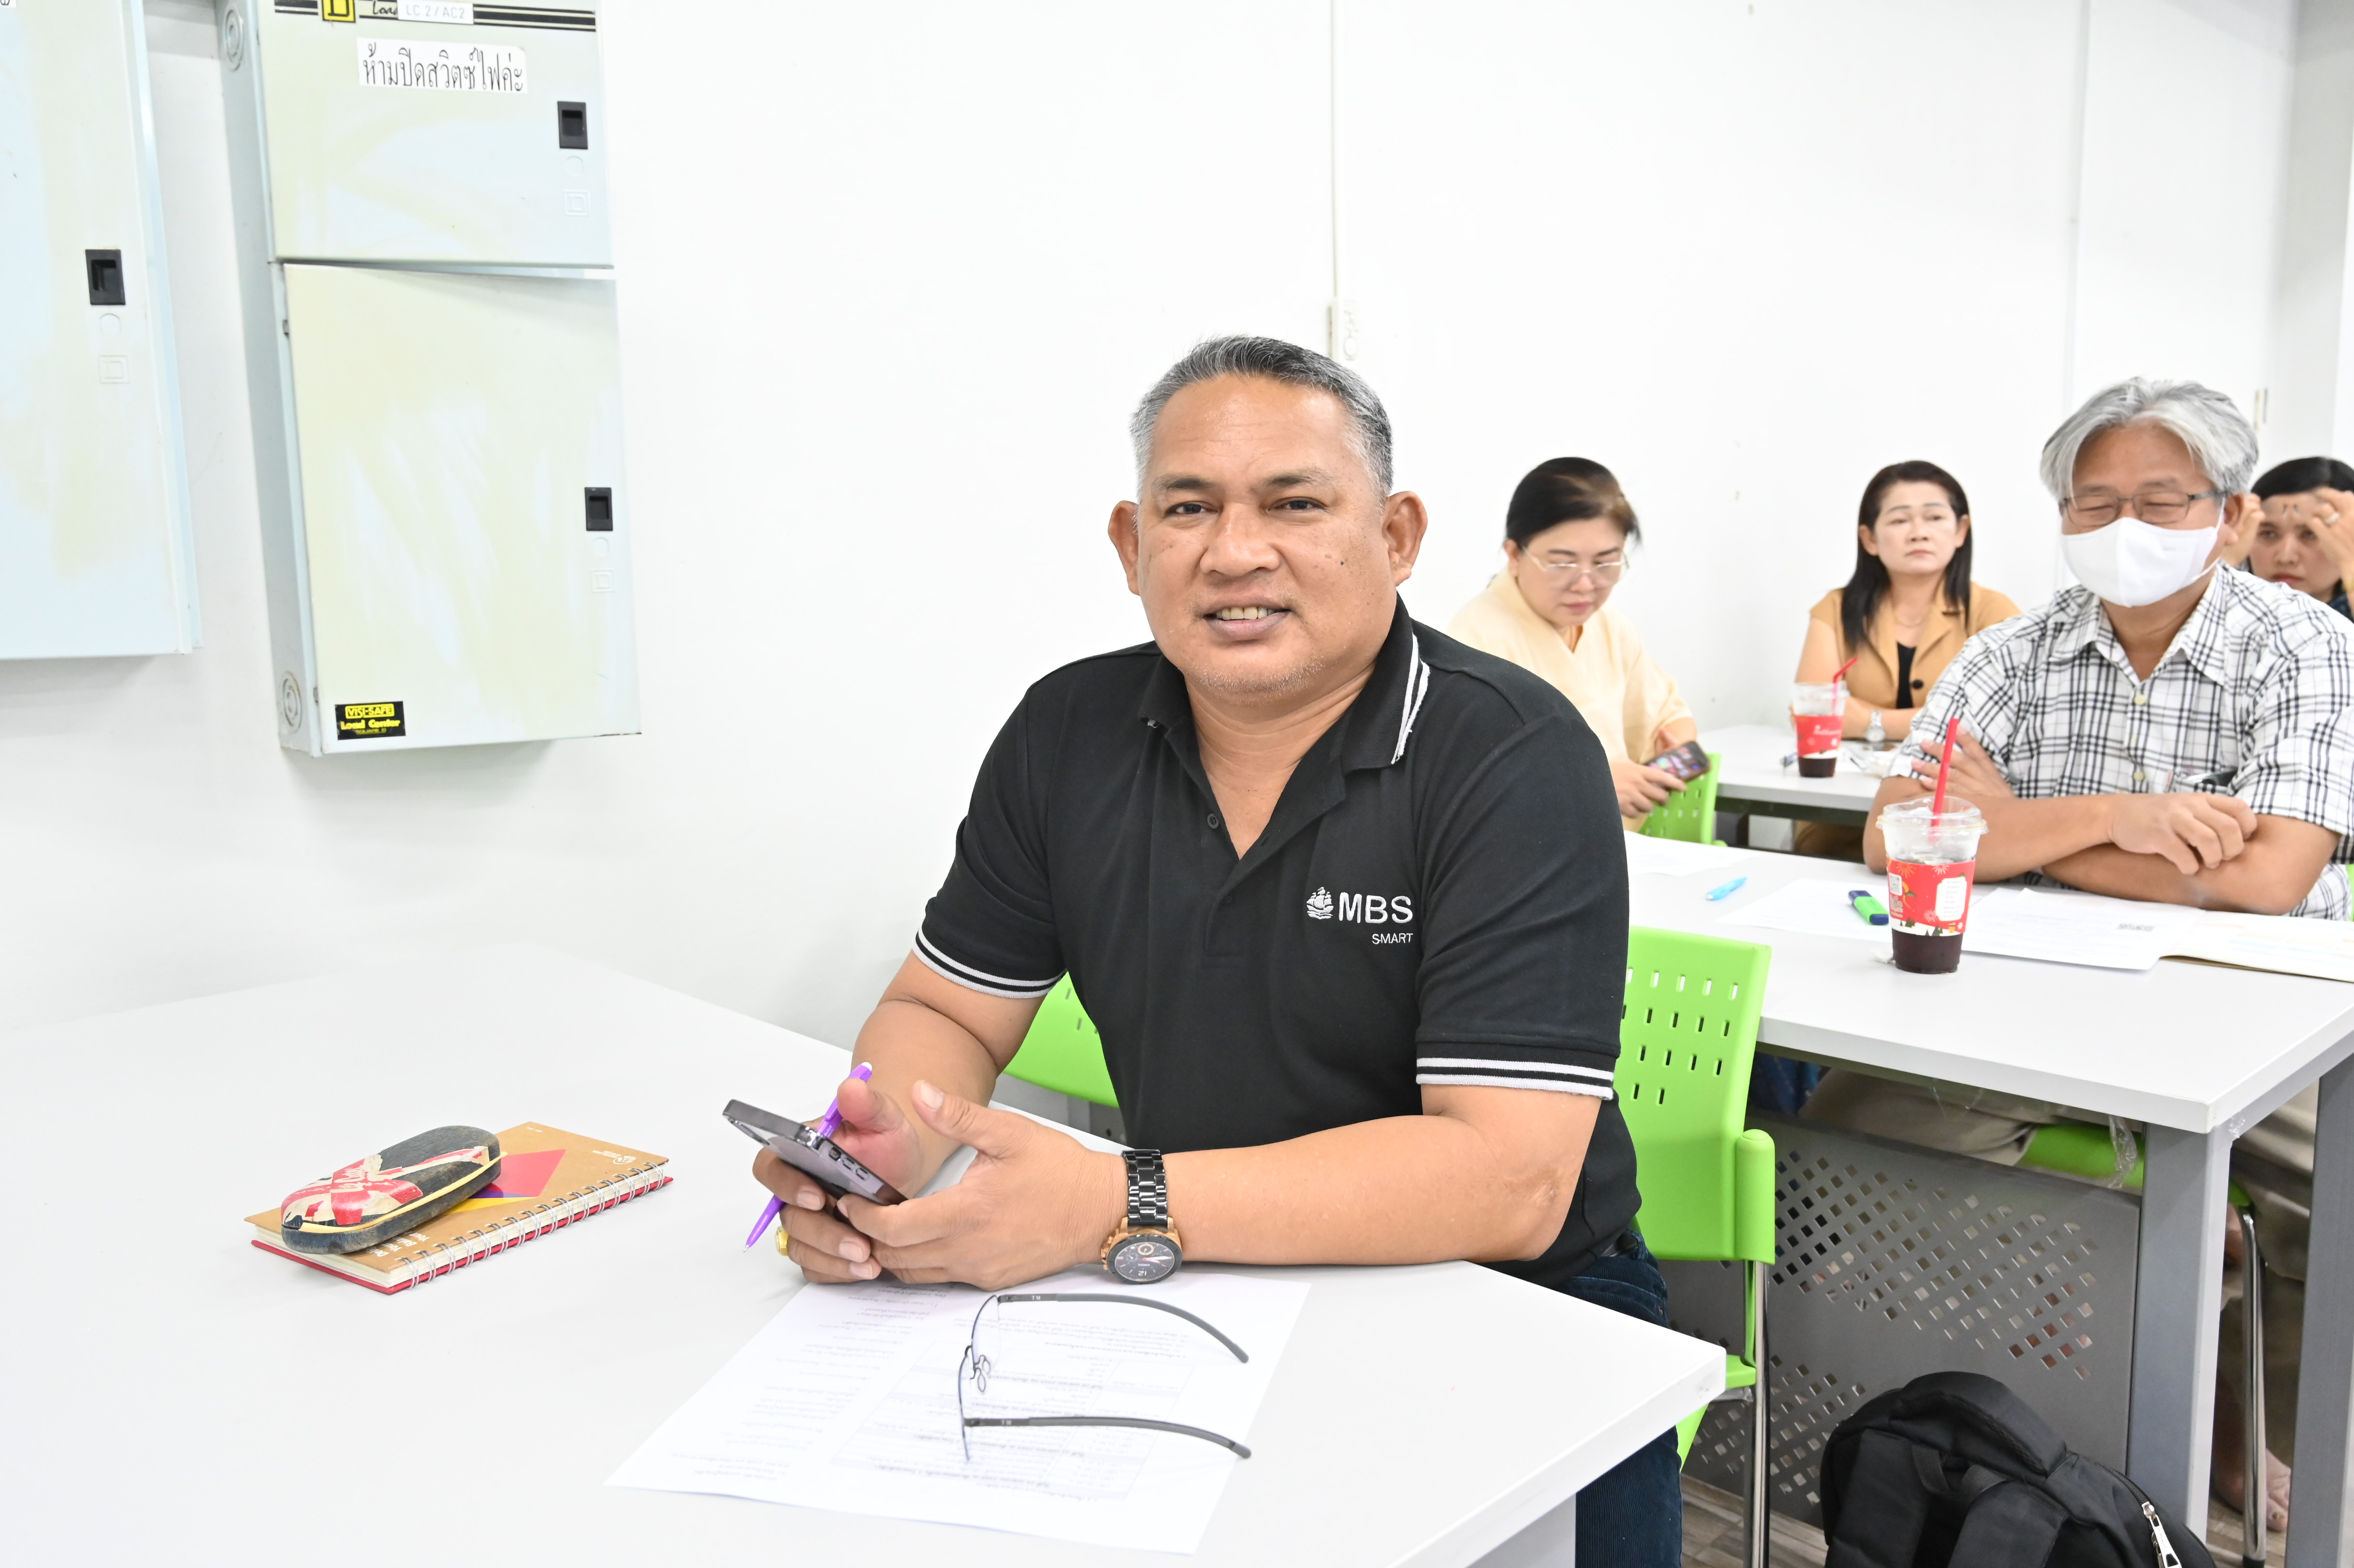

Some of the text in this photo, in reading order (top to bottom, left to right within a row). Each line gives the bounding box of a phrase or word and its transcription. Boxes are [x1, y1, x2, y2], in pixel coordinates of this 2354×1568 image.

[406, 4, 420, 16] LC
[1339, 892, 1413, 924] MBS
[1372, 933, 1414, 945] SMART
[409, 1233, 430, 1242] Your
